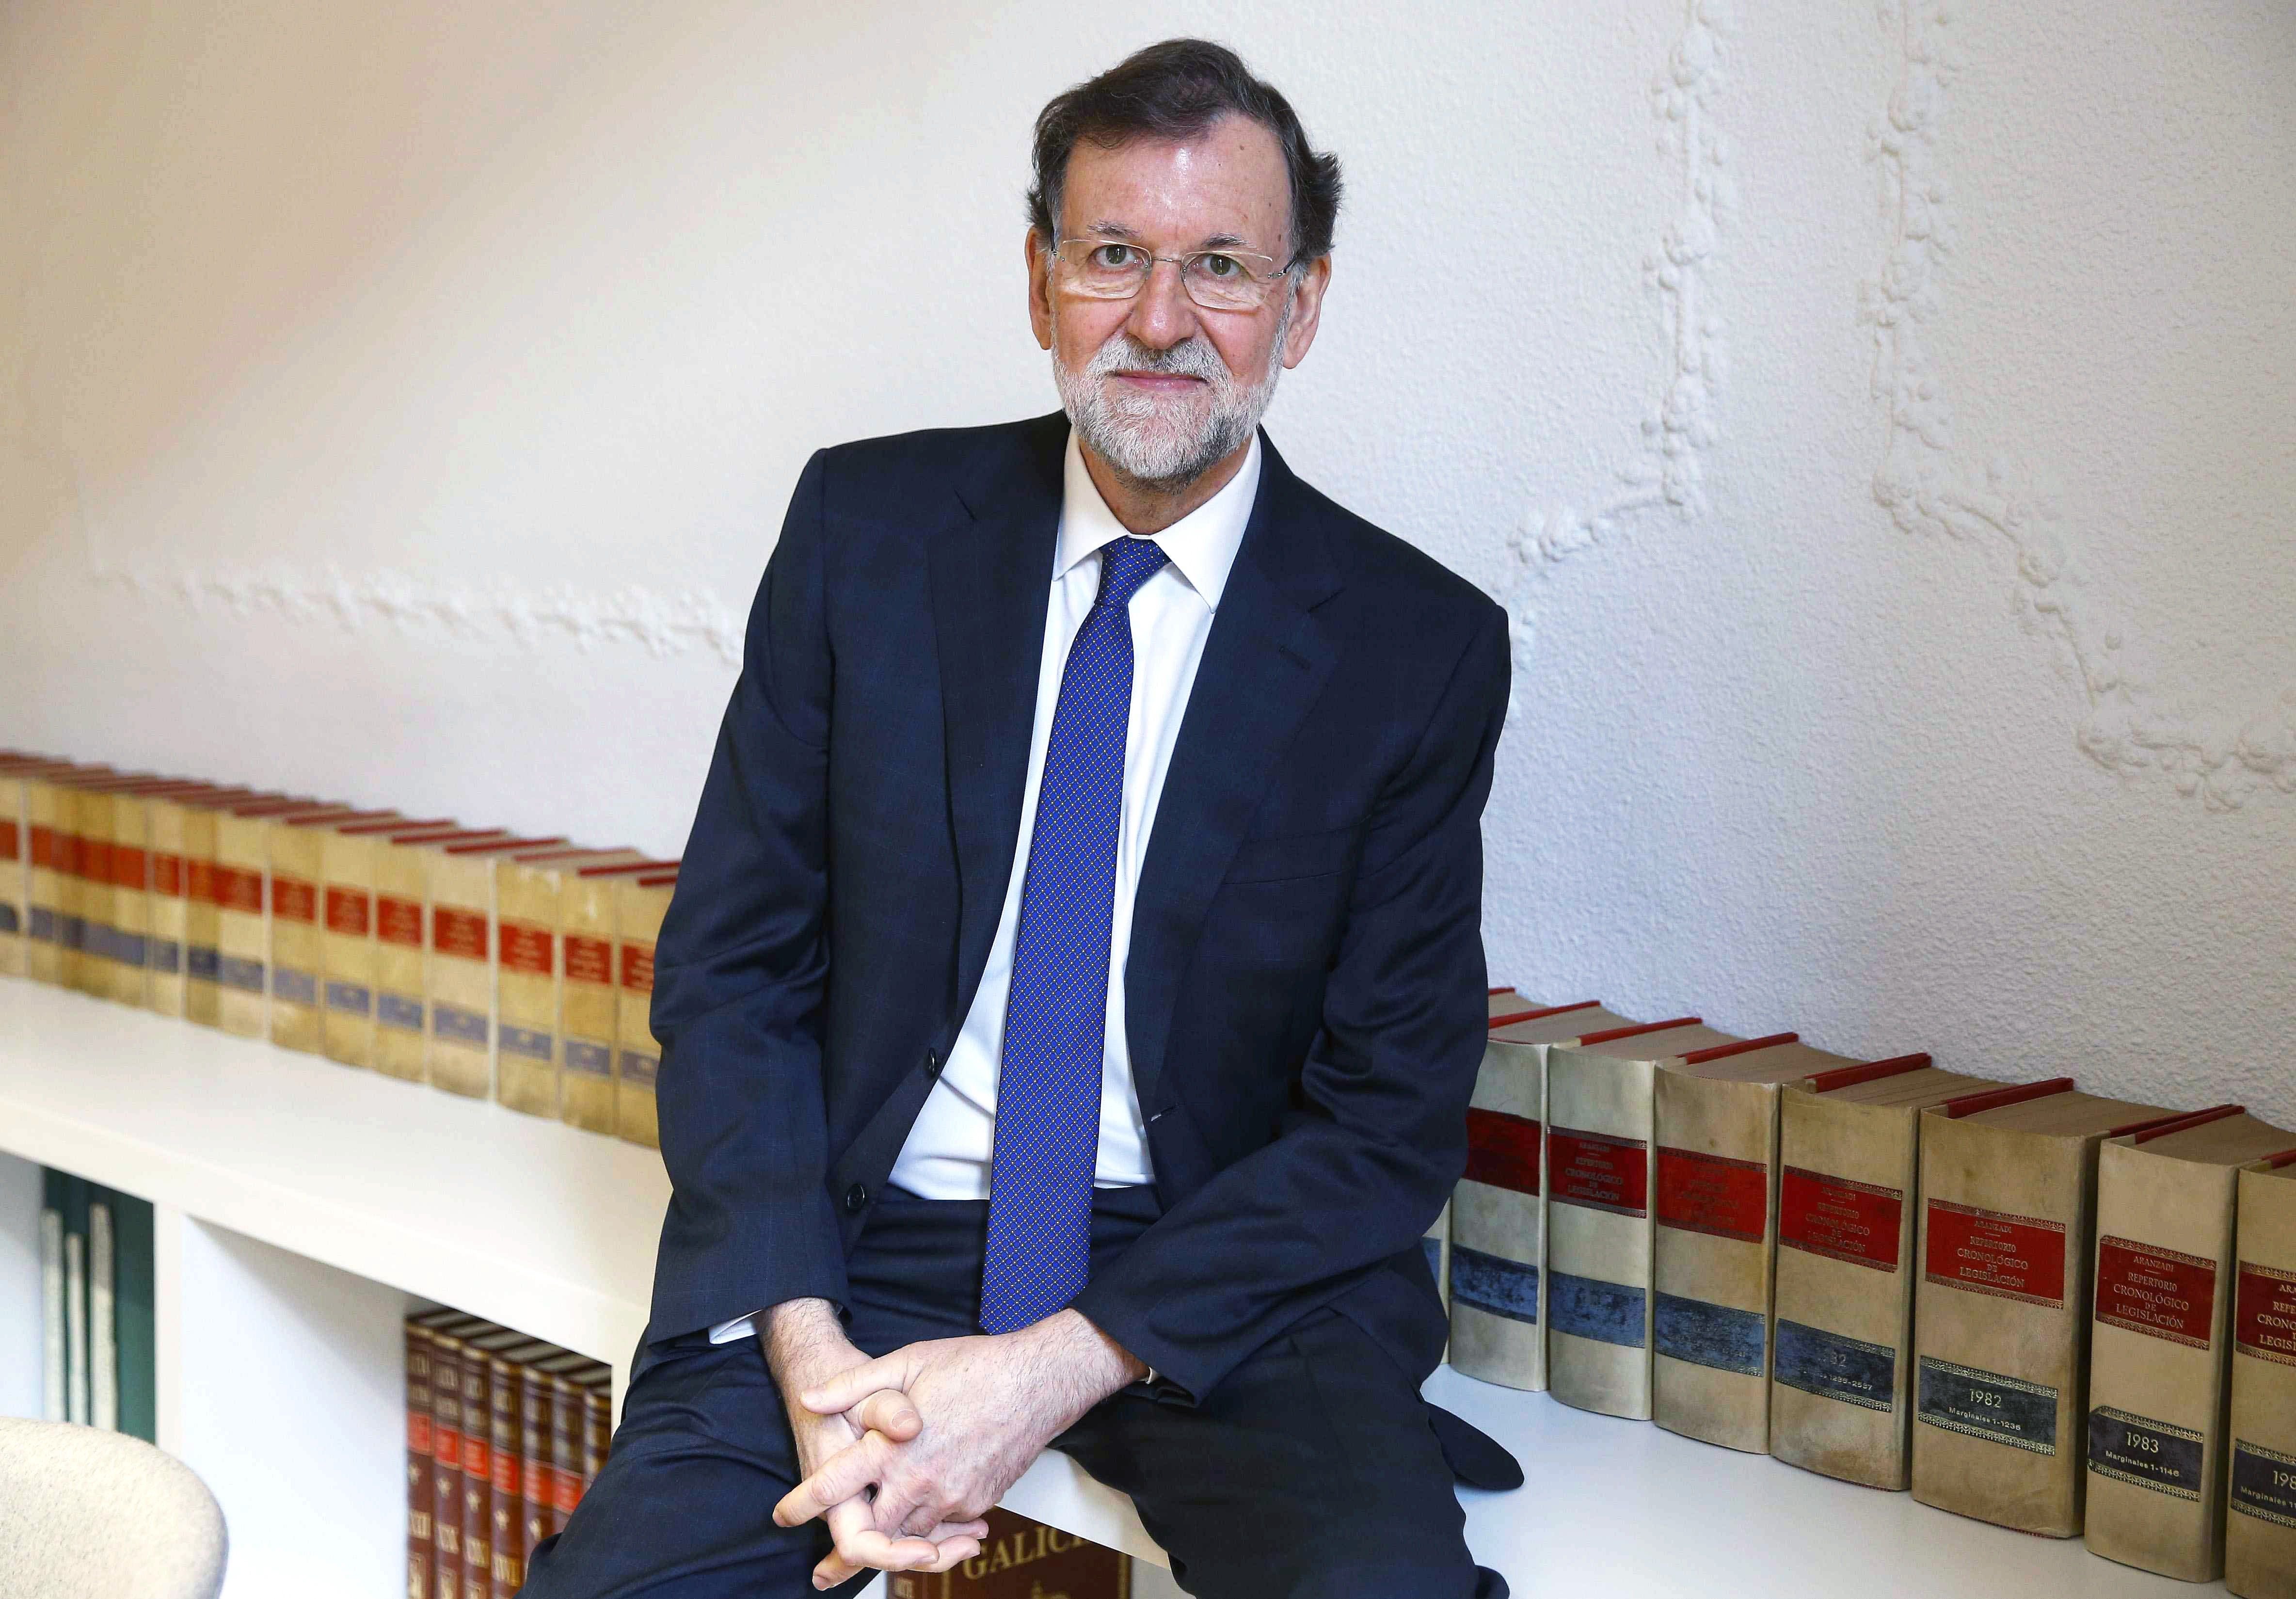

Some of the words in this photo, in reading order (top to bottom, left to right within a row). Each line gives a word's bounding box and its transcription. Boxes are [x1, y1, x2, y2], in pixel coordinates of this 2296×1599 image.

[1805, 1213, 1870, 1236] CRONOLÓGICO
[1974, 1220, 2012, 1233] ARANZADI
[1970, 1236, 2017, 1253] REPERTORIO
[1957, 1248, 2028, 1269] CRONOLÓGICO
[1988, 1264, 1997, 1272] DE
[2133, 1256, 2173, 1272] ARANZADI
[1960, 1266, 2025, 1287] LEGISLACIÓN
[2128, 1272, 2177, 1292] REPERTORIO
[2114, 1284, 2189, 1311] CRONOLÓGICO
[2145, 1302, 2157, 1311] DE
[2116, 1304, 2184, 1329] LEGISLACIÓN
[1970, 1389, 2002, 1408] 1982
[1949, 1407, 1990, 1423] Marginales
[2126, 1432, 2159, 1453] 1983
[2105, 1451, 2148, 1469] Marginales
[2150, 1464, 2180, 1477] 1-1146
[2241, 1485, 2286, 1505] Marginales
